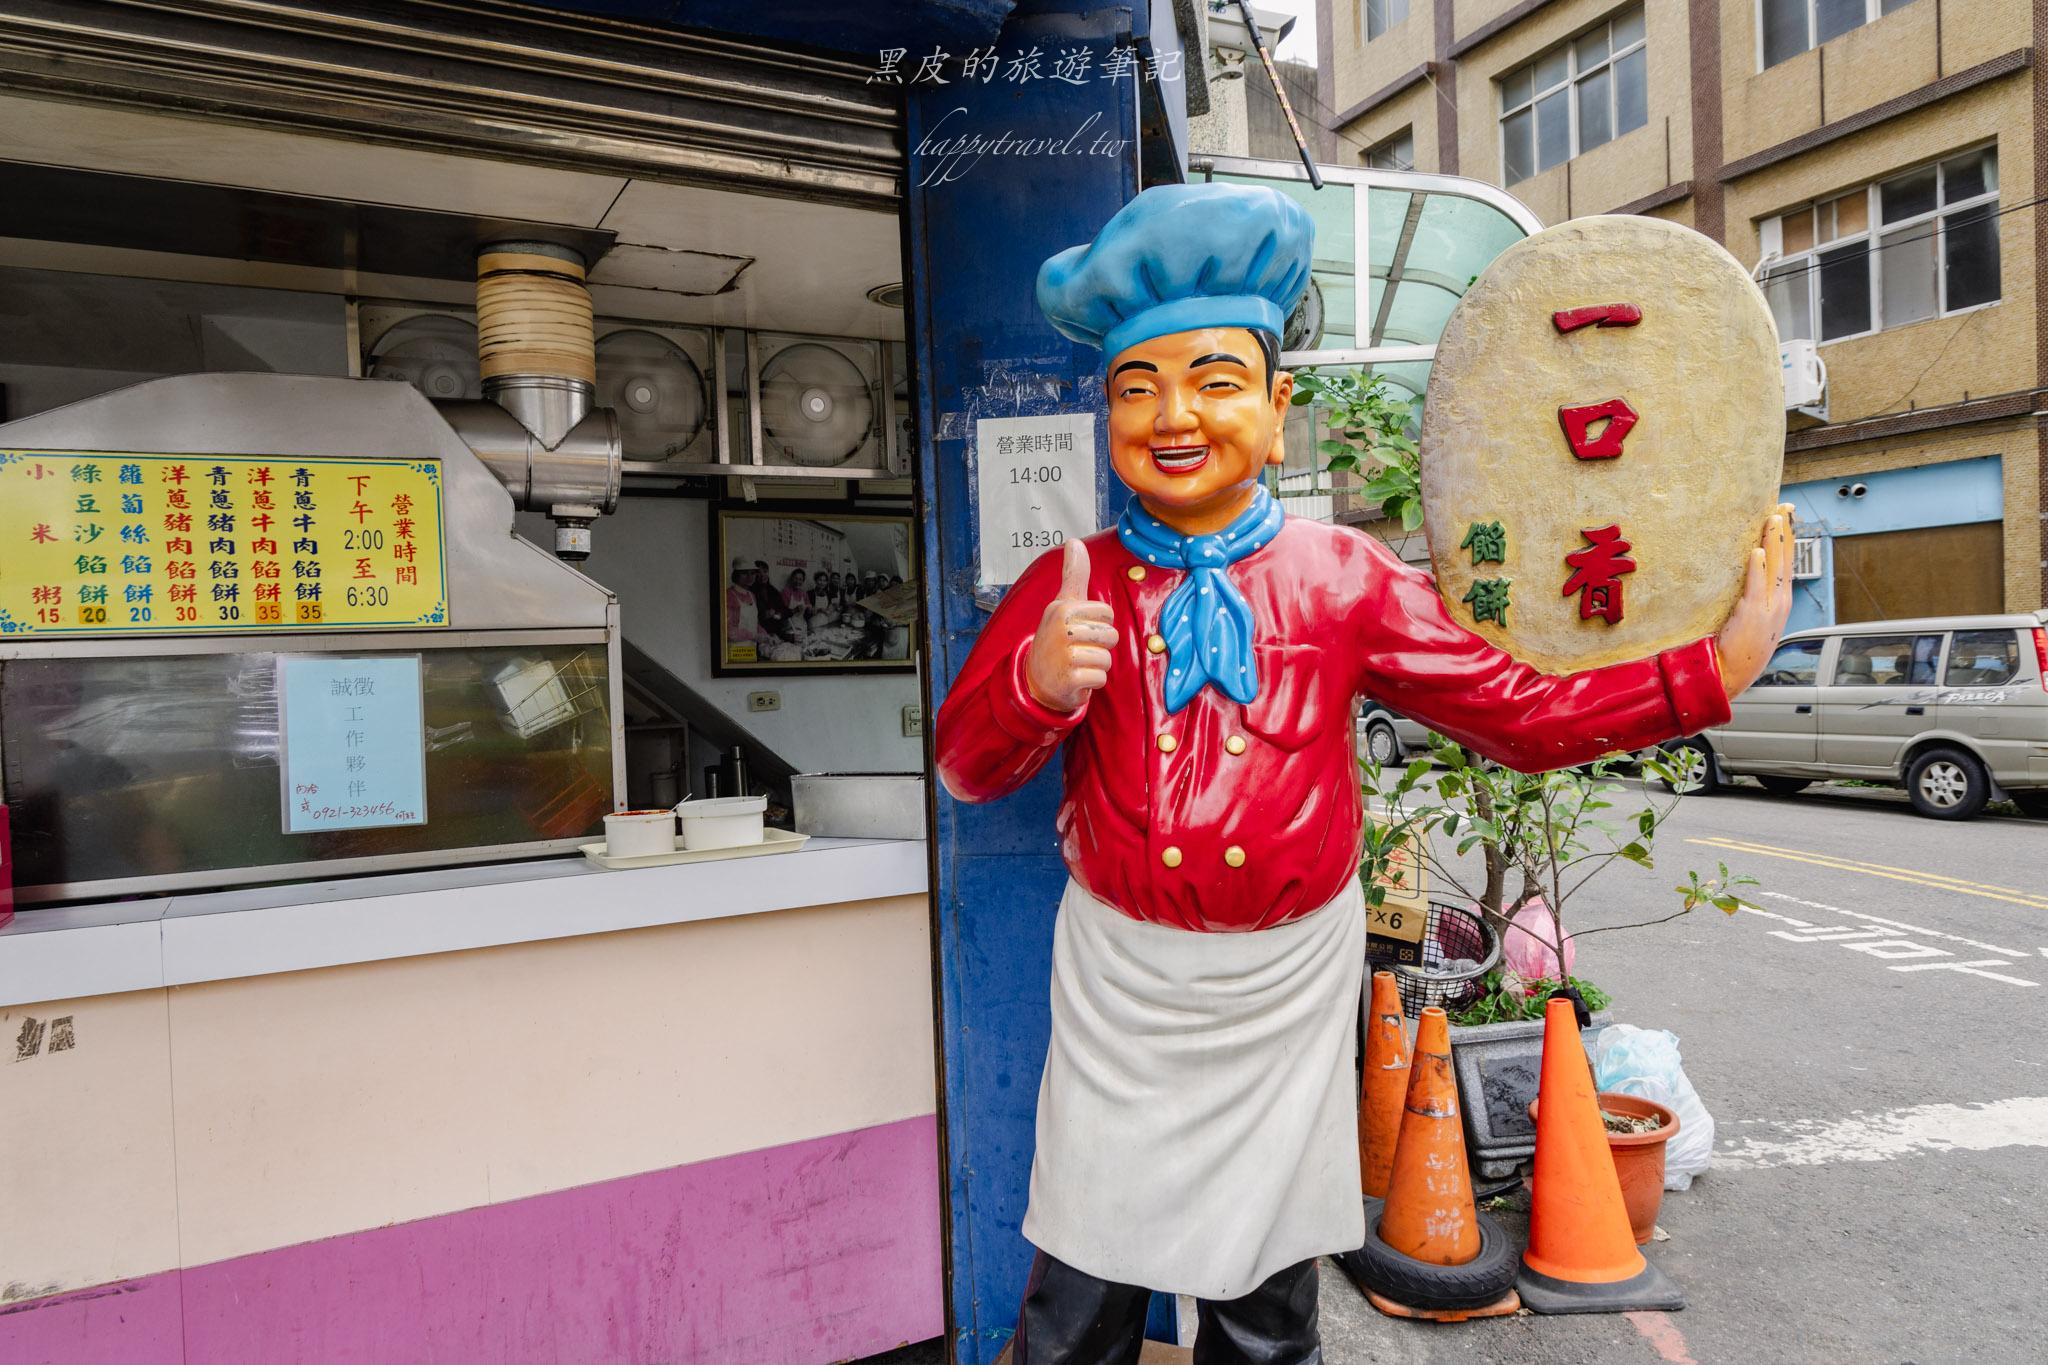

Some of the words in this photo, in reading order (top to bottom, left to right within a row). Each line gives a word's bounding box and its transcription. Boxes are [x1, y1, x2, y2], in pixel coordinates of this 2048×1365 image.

[996, 432, 1073, 455] 營業時間
[1550, 302, 1643, 626] 一口香
[1010, 465, 1063, 484] 14:00
[26, 463, 62, 606] 小米粥
[69, 463, 109, 605] 綠豆沙餡餅
[118, 463, 154, 604] 蘿蔔絲餡餅
[161, 465, 197, 603] 洋蔥豬肉餡餅
[205, 466, 240, 602] 青蔥豬肉餡餅
[247, 467, 281, 602] 洋蔥牛肉餡餅
[289, 468, 323, 602] 青蔥牛肉餡餅
[391, 494, 418, 586] 營業時間
[1011, 530, 1064, 548] 18:30
[1461, 520, 1512, 627] 餡餅
[37, 608, 60, 623] 15
[82, 608, 106, 623] 20
[130, 607, 151, 622] 20
[176, 606, 197, 621] 30
[219, 605, 240, 620] 30
[258, 605, 280, 620] 35
[300, 605, 322, 619] 35
[331, 677, 375, 697] 誠徵
[344, 705, 367, 798] 工作夥伴
